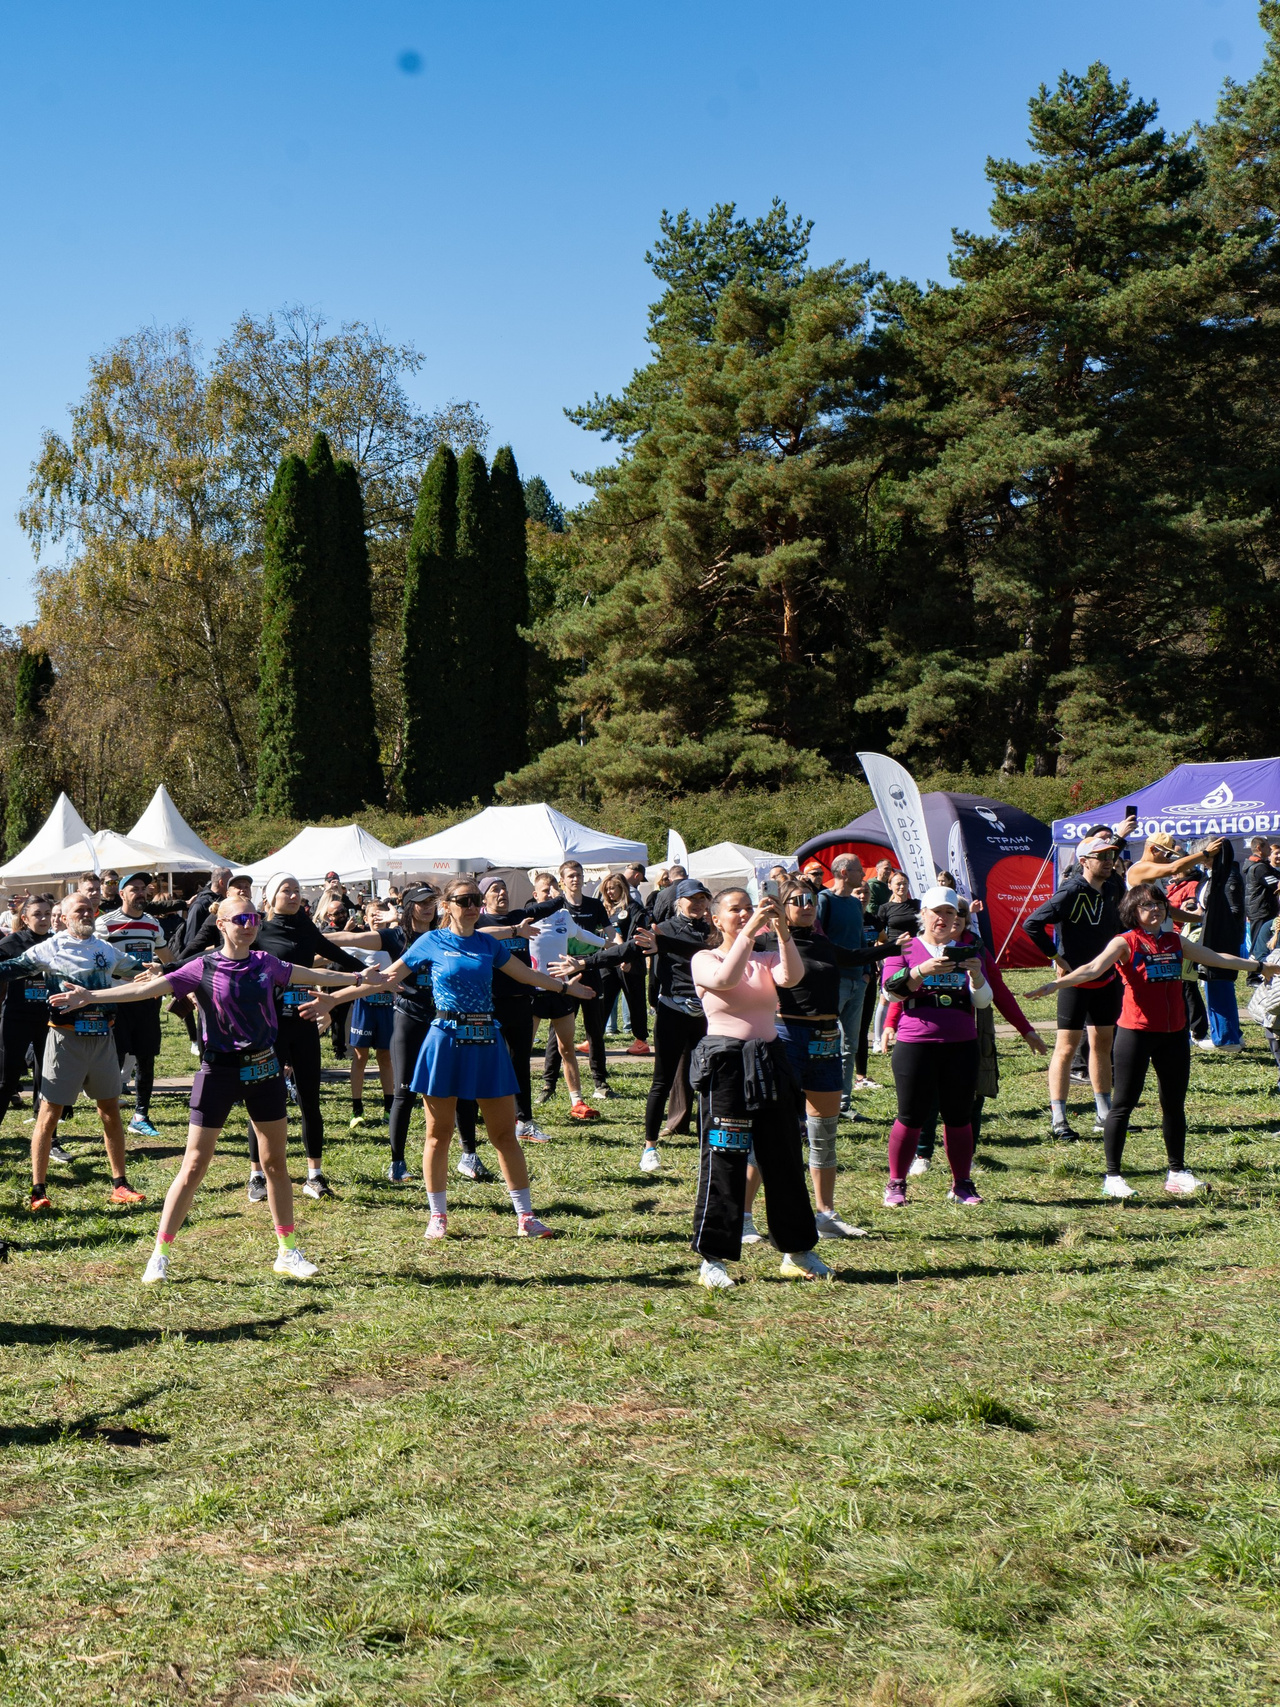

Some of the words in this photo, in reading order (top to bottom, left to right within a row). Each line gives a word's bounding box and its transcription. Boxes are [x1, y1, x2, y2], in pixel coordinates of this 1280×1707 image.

[1062, 822, 1124, 840] ЗОА
[986, 835, 1034, 844] СТРАНА
[1032, 893, 1054, 902] ВЕТ
[465, 1026, 490, 1037] 1151
[718, 1131, 749, 1145] 1215
